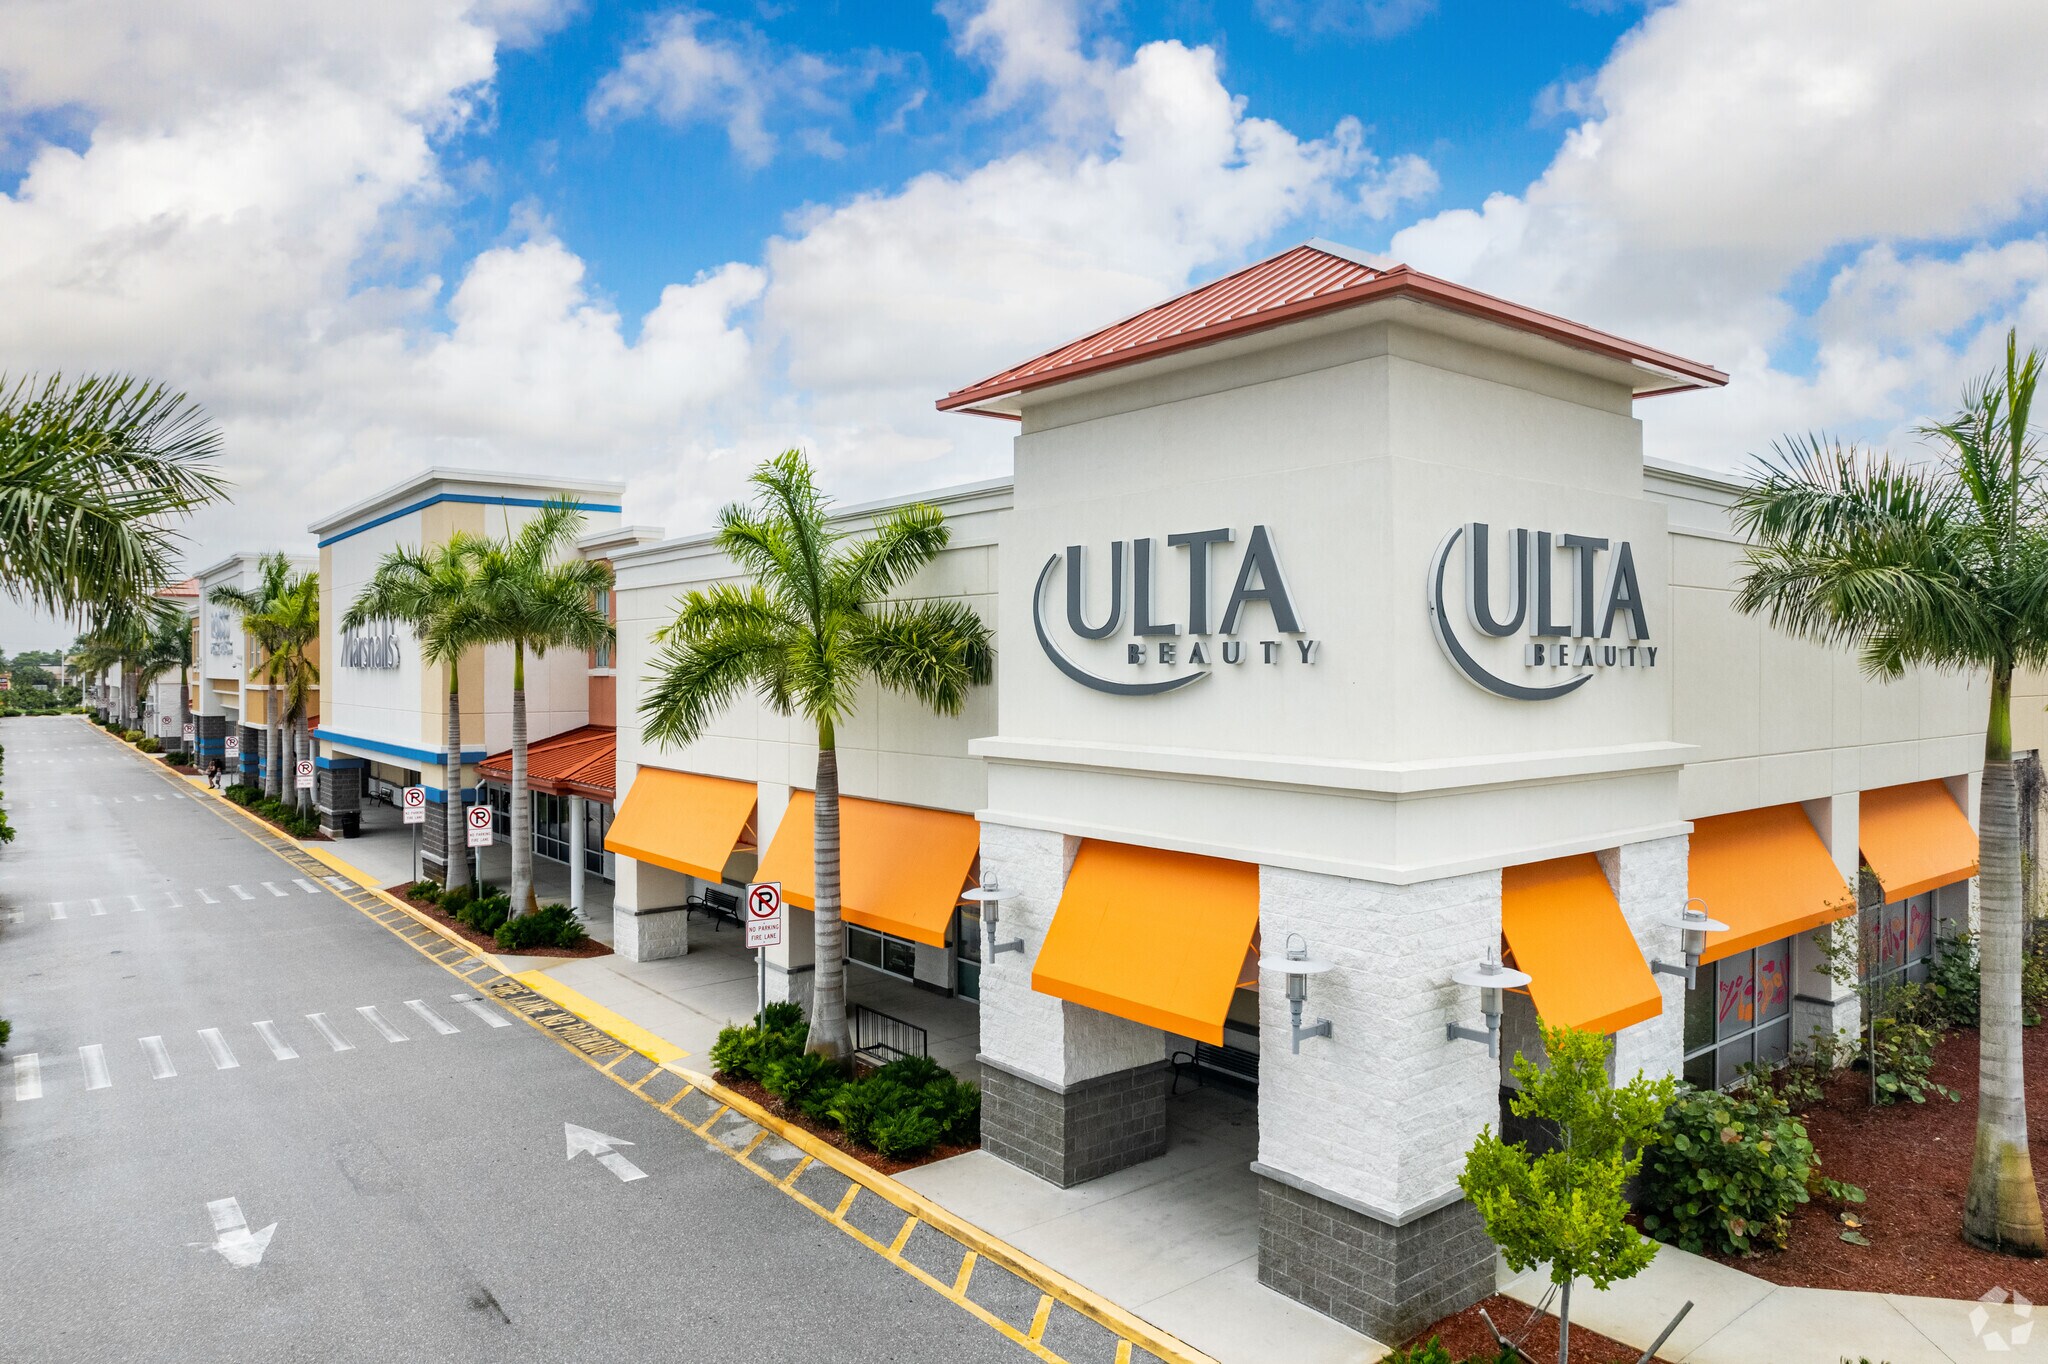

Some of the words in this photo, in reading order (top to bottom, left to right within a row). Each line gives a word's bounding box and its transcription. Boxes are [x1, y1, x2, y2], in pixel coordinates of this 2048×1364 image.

[1066, 525, 1306, 640] ULTA
[1465, 522, 1650, 640] ULTA
[340, 613, 400, 668] Marshalls
[1127, 640, 1320, 665] BEAUTY
[1525, 643, 1658, 668] BEAUTY
[505, 994, 558, 1015] LANE
[534, 1012, 576, 1028] NO
